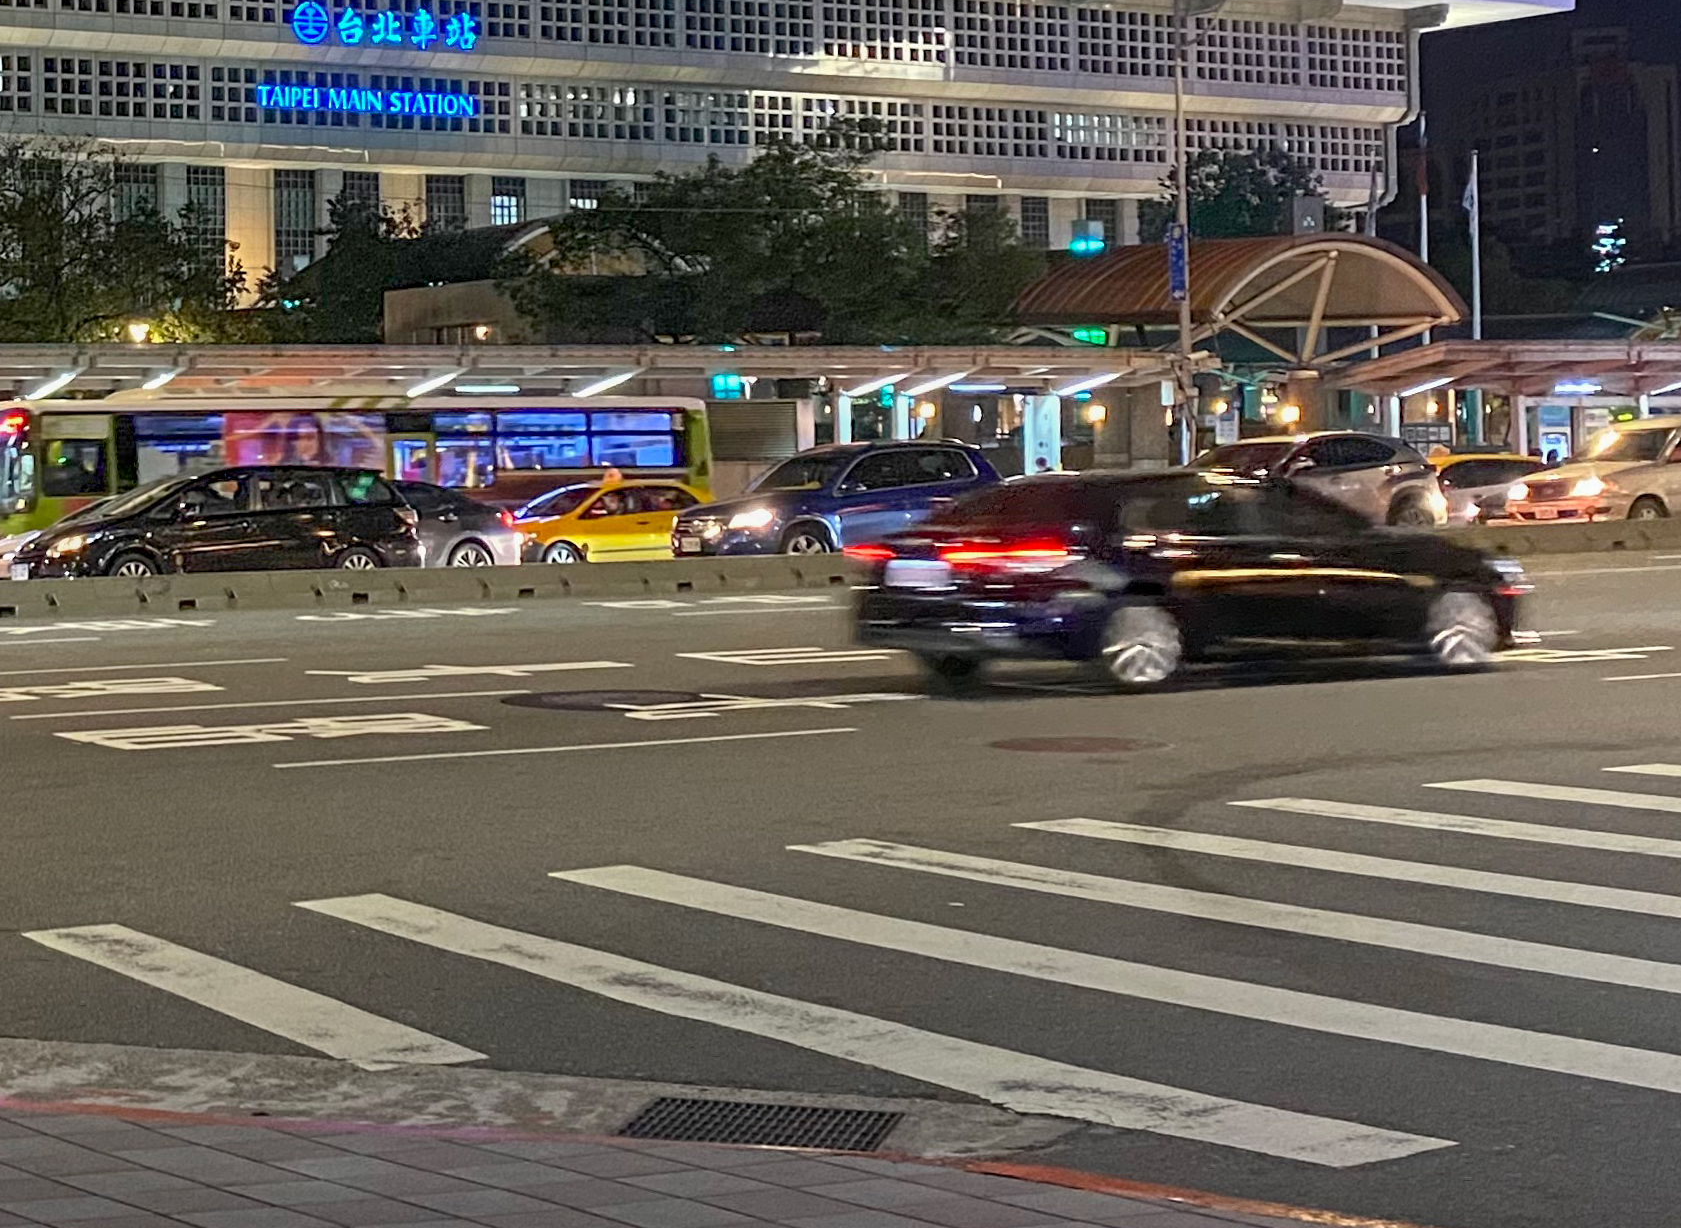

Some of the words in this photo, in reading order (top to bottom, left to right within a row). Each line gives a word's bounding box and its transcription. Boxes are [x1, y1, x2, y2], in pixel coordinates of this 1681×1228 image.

[337, 7, 477, 50] 台北車站
[257, 85, 318, 109] TAIPEI
[328, 88, 382, 111] MAIN
[389, 91, 474, 116] STATION
